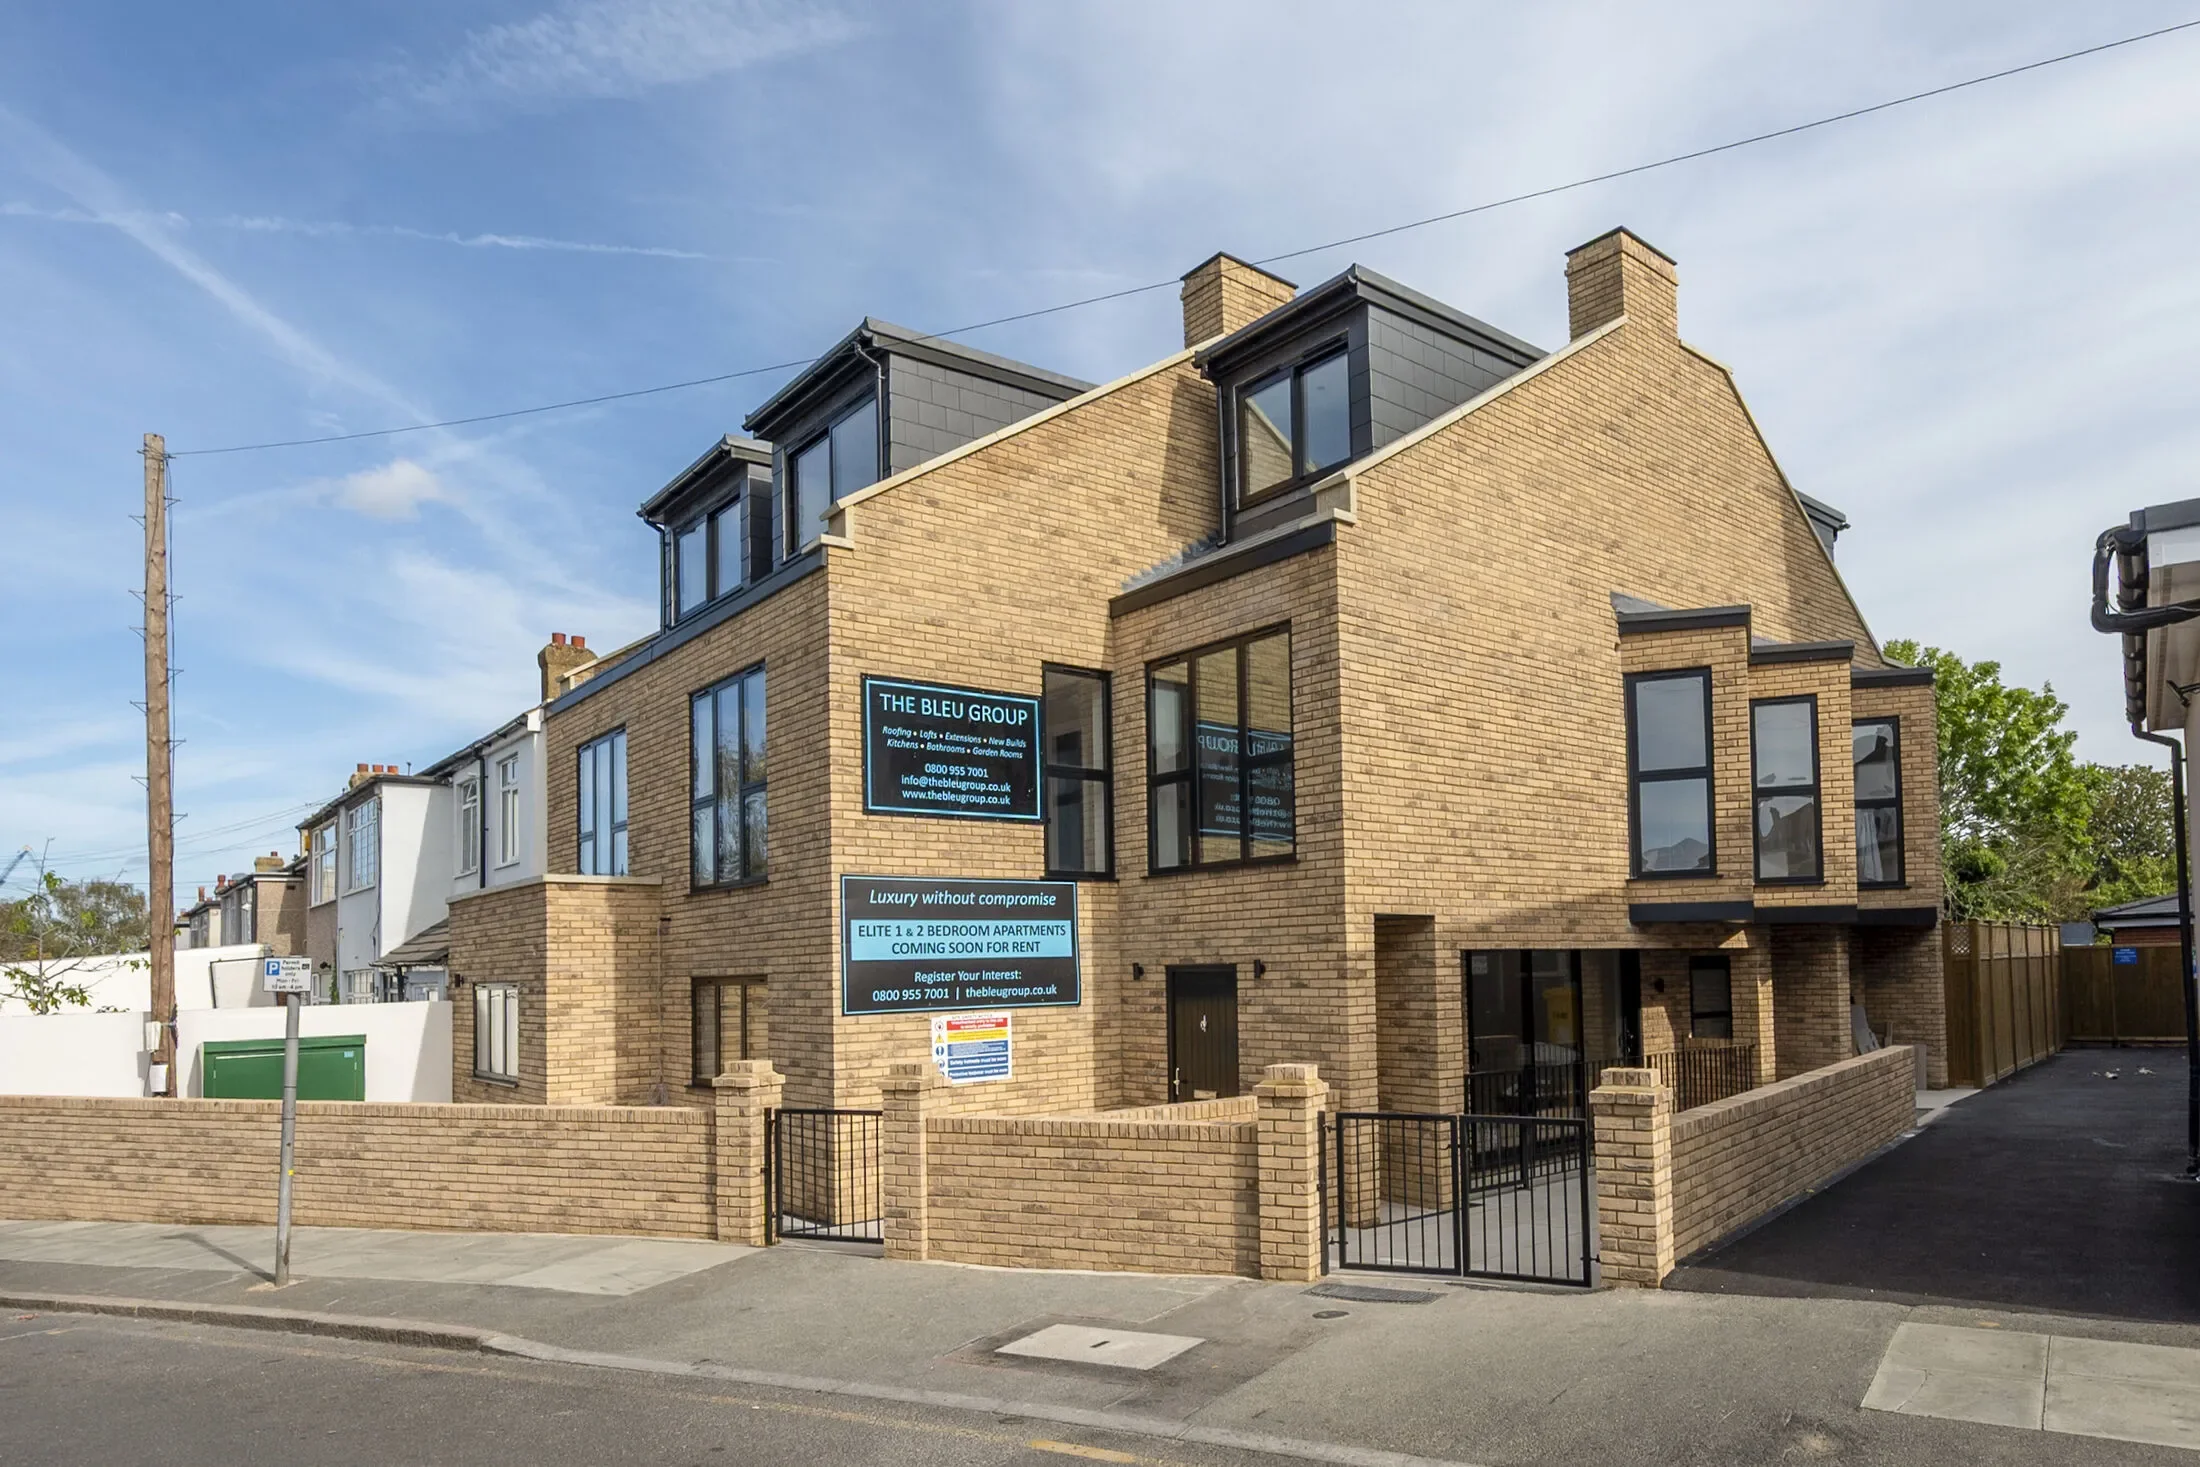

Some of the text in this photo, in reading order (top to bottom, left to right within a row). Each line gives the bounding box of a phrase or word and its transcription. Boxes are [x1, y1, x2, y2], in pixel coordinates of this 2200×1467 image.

[880, 693, 1028, 726] THE BLEU GROUP
[882, 726, 1026, 748] Roofing Lofts Extensions New Builds
[887, 739, 1023, 759] Kitchens Bathrooms Garden Rooms
[925, 763, 988, 778] 0800 955 7001
[902, 775, 1011, 792] info@thebleugroup.co.uk
[902, 789, 1010, 805] www.thebleugroup.co.uk
[869, 889, 1056, 908] Luxury without compromise
[858, 925, 1066, 937] ELITE 1 & 2 BEDROOM APARTMENTS
[892, 941, 1040, 954] COMING SOON FOR RENT
[269, 962, 279, 975] P
[914, 970, 1022, 984] Register Your Interest:
[872, 989, 899, 1002] 0800
[902, 989, 921, 1000] 955
[924, 988, 949, 999] 7001
[966, 984, 1057, 999] thebleugroup.co.uk
